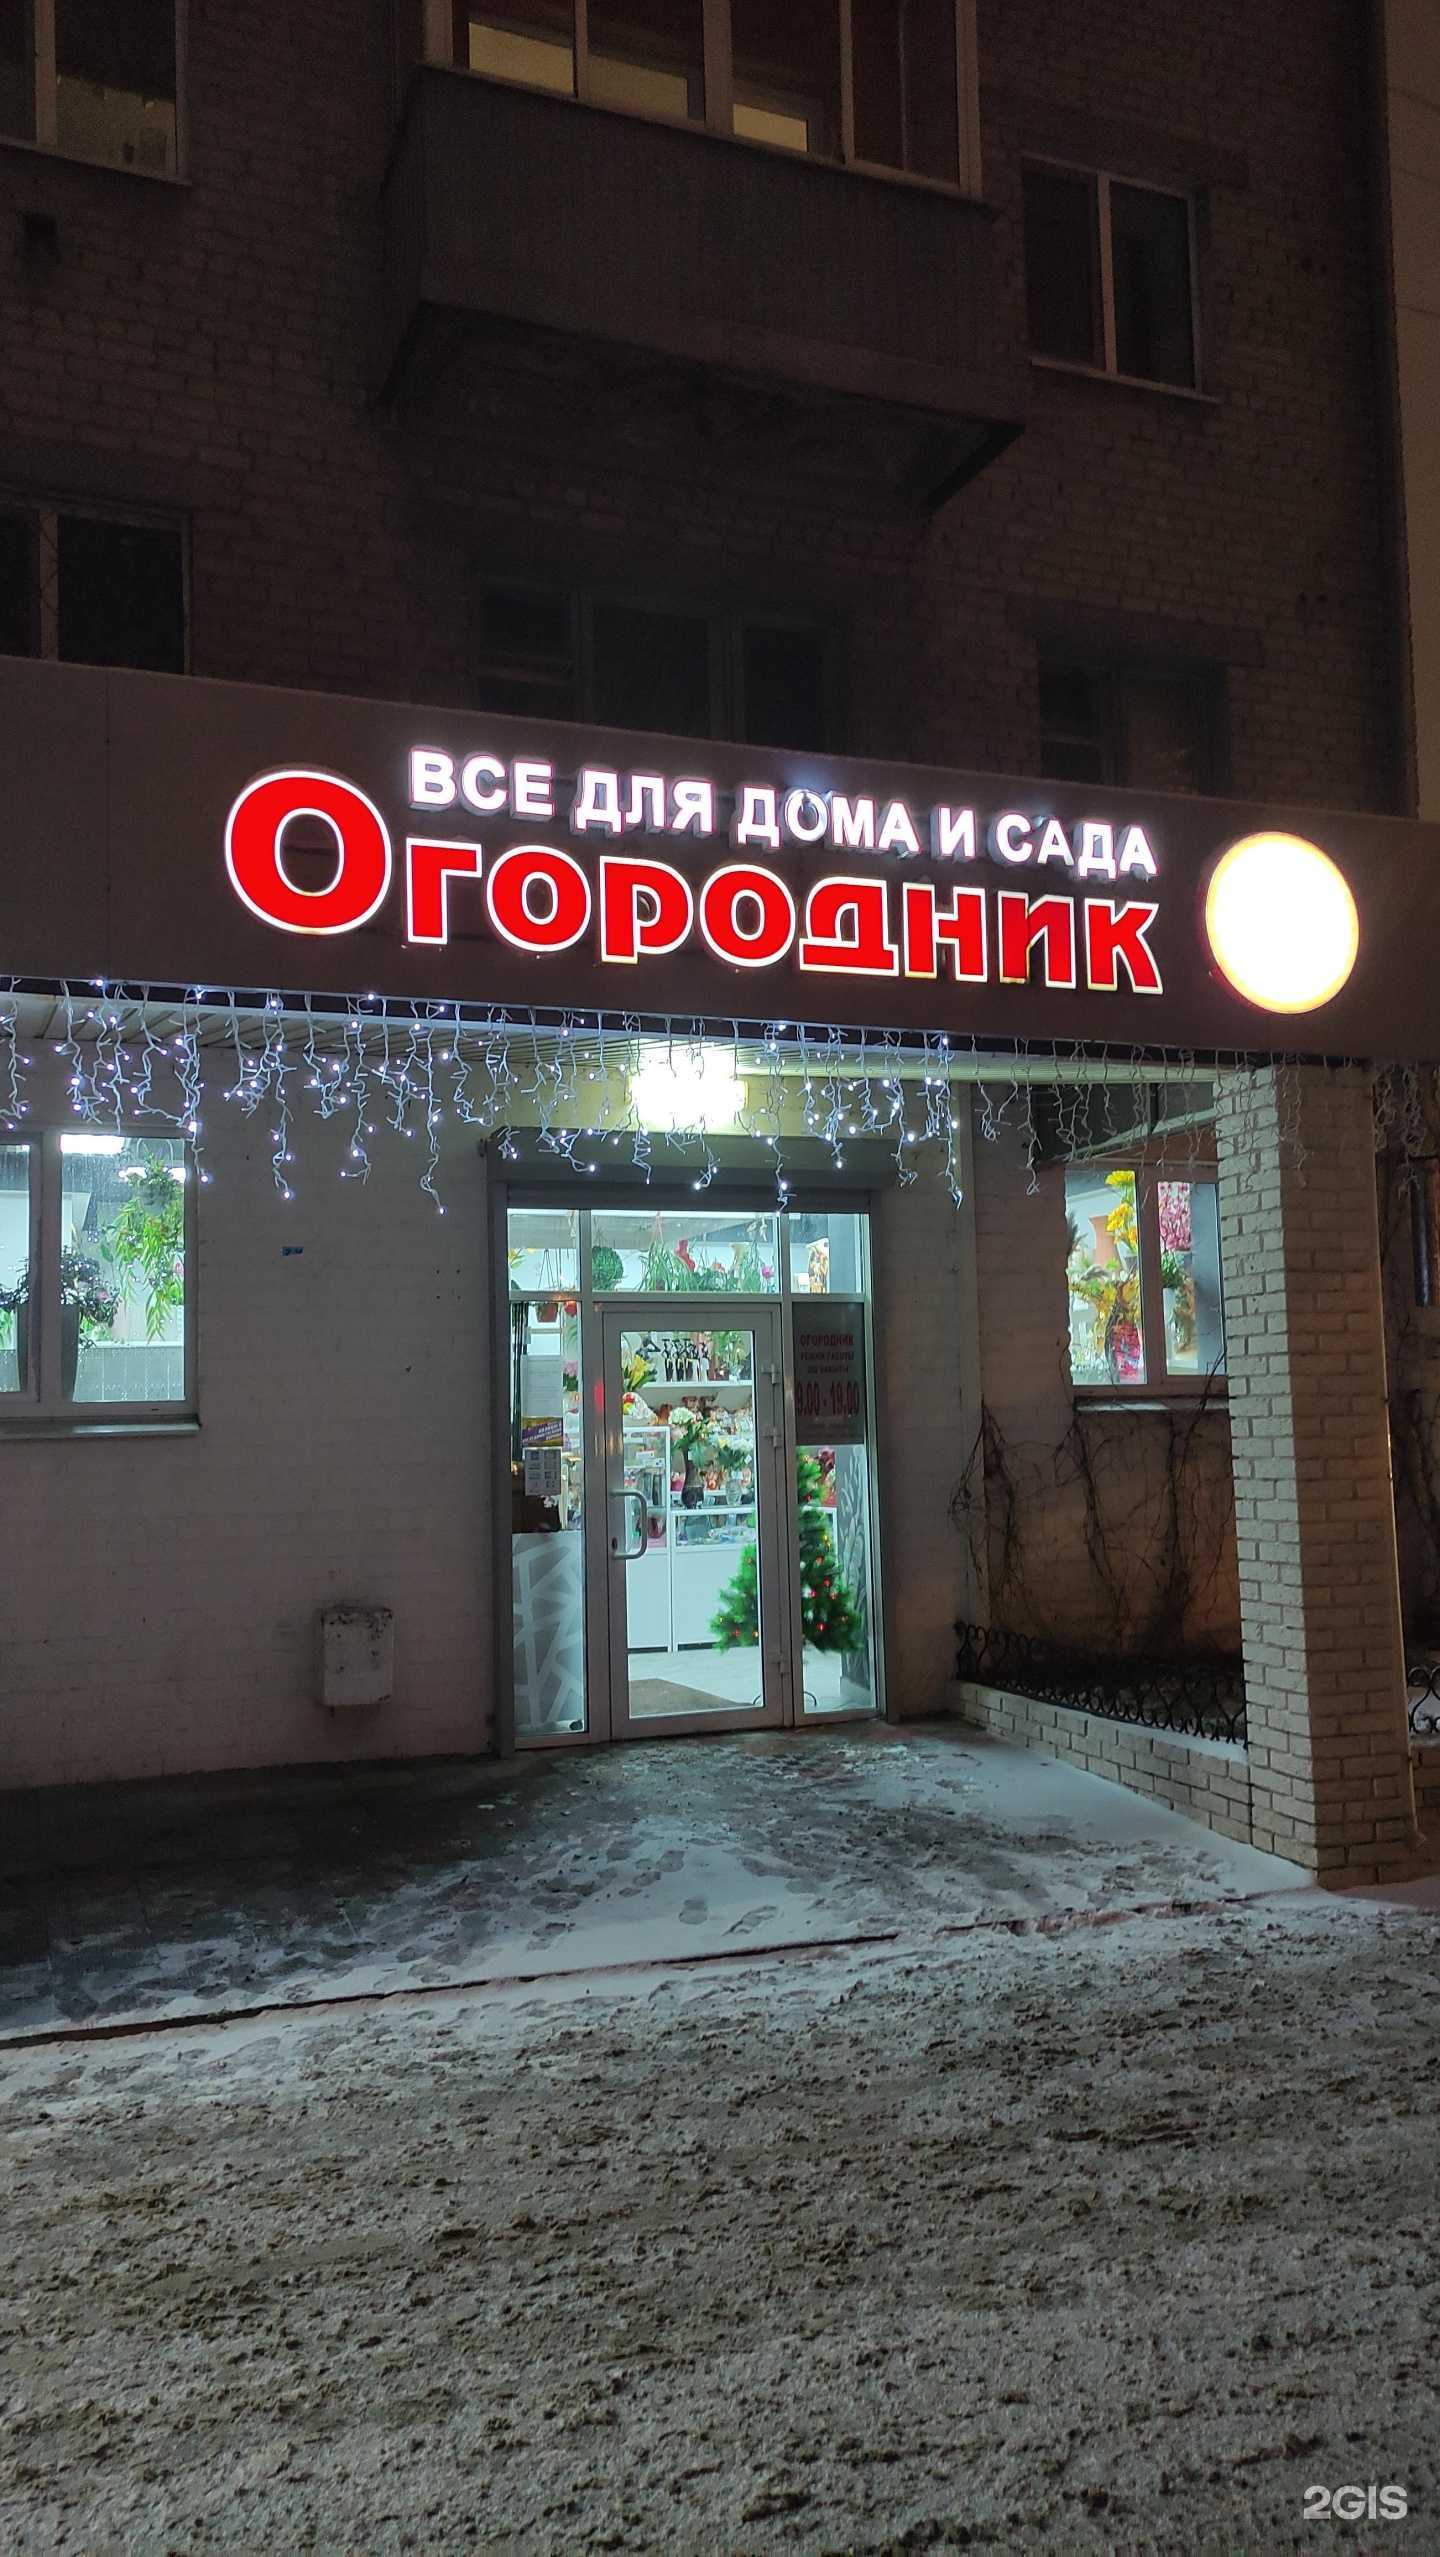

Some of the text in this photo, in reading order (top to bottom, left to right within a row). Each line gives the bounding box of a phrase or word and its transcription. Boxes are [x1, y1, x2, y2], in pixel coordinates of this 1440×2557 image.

[409, 748, 1159, 880] ВСЕ ДЛЯ ДОМА И САДА
